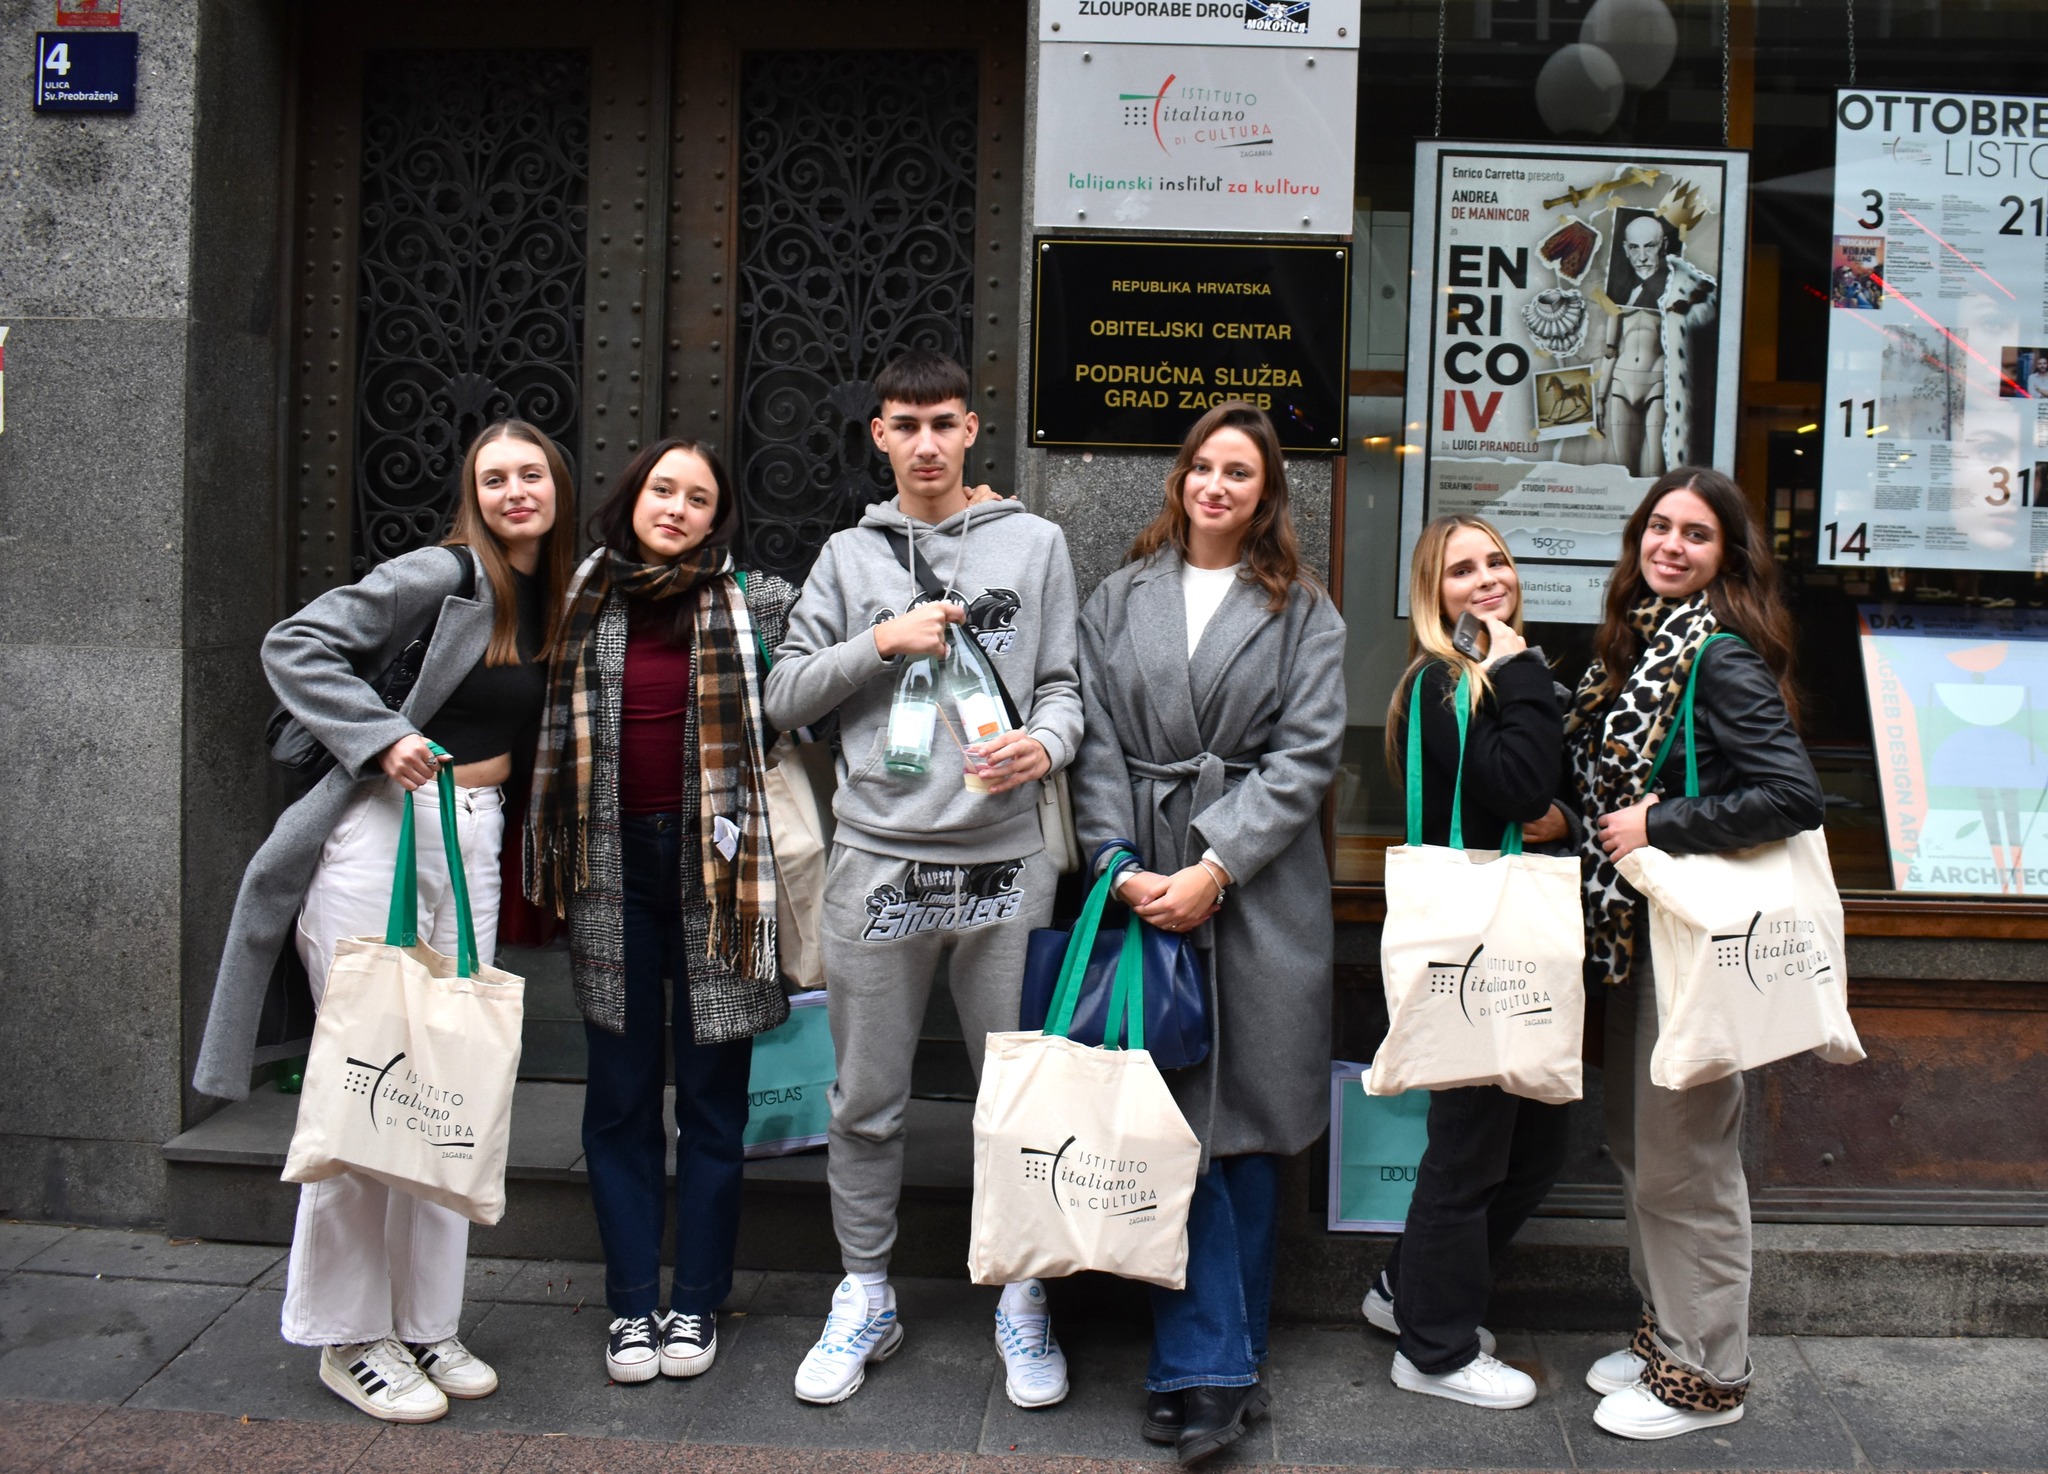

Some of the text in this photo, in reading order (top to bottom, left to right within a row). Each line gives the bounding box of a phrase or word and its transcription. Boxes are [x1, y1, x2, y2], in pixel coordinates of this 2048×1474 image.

[1078, 1, 1244, 18] ZLOUPORABE DROG
[1246, 18, 1307, 33] MOKOŠICA
[45, 43, 71, 76] 4
[45, 81, 70, 89] ULICA
[58, 90, 119, 102] Preobraženja
[1181, 86, 1257, 106] ISTITUTO
[1163, 105, 1245, 122] italiano
[1838, 93, 2048, 138] OTTOBRE
[1175, 124, 1272, 145] DI CULTURA
[1240, 150, 1273, 158] ZAGABRIA
[1069, 172, 1320, 196] talijanski institut za kulturu
[1453, 167, 1565, 183] Enrico Carretta presenta
[1452, 190, 1499, 204] ANDREA
[1451, 206, 1530, 222] DE MANINCOR
[1858, 189, 1884, 229] 3
[1999, 195, 2044, 237] 21
[1450, 226, 1458, 236] in
[1449, 244, 1529, 289] EN
[1112, 280, 1272, 295] REPUBLIKA HRVATSKA
[1446, 293, 1503, 336] RI
[1090, 320, 1292, 340] OBITELJSKI CENTAR
[1444, 341, 1531, 386] CO
[1075, 361, 1303, 388] PODRUČNA SLUŽBA
[1105, 389, 1169, 408] GRAD
[1442, 389, 1504, 433] IV
[1839, 398, 1876, 438] 11
[1452, 439, 1478, 451] LUIGI
[1479, 440, 1539, 453] PIRANDELLO
[1440, 482, 1472, 490] SERAFINO
[1521, 484, 1545, 492] STUDIO
[1547, 485, 1574, 493] PUSKAS
[1984, 466, 2031, 507] 31
[1532, 538, 1552, 548] 150
[1825, 521, 1871, 561] 14
[1588, 579, 1600, 587] 15
[1868, 613, 1915, 630] DA2
[1886, 724, 1913, 806] DESIGN
[1898, 813, 1922, 858] ART
[922, 891, 968, 905] Londn
[1487, 957, 1537, 973] ISTITUTO
[1471, 976, 1526, 992] italiano
[1767, 973, 1778, 983] DI
[1480, 990, 1551, 1016] DI CULTURA
[382, 1083, 450, 1121] italiano
[748, 1086, 803, 1107] UGLAS
[386, 1116, 475, 1138] DI CULTURA
[441, 1151, 473, 1160] ZAGABRIA
[1079, 1151, 1148, 1173] ISTITUTO
[1061, 1166, 1136, 1191] italiano
[1380, 1166, 1416, 1182] DOU
[1070, 1189, 1157, 1210] DI CULTURA
